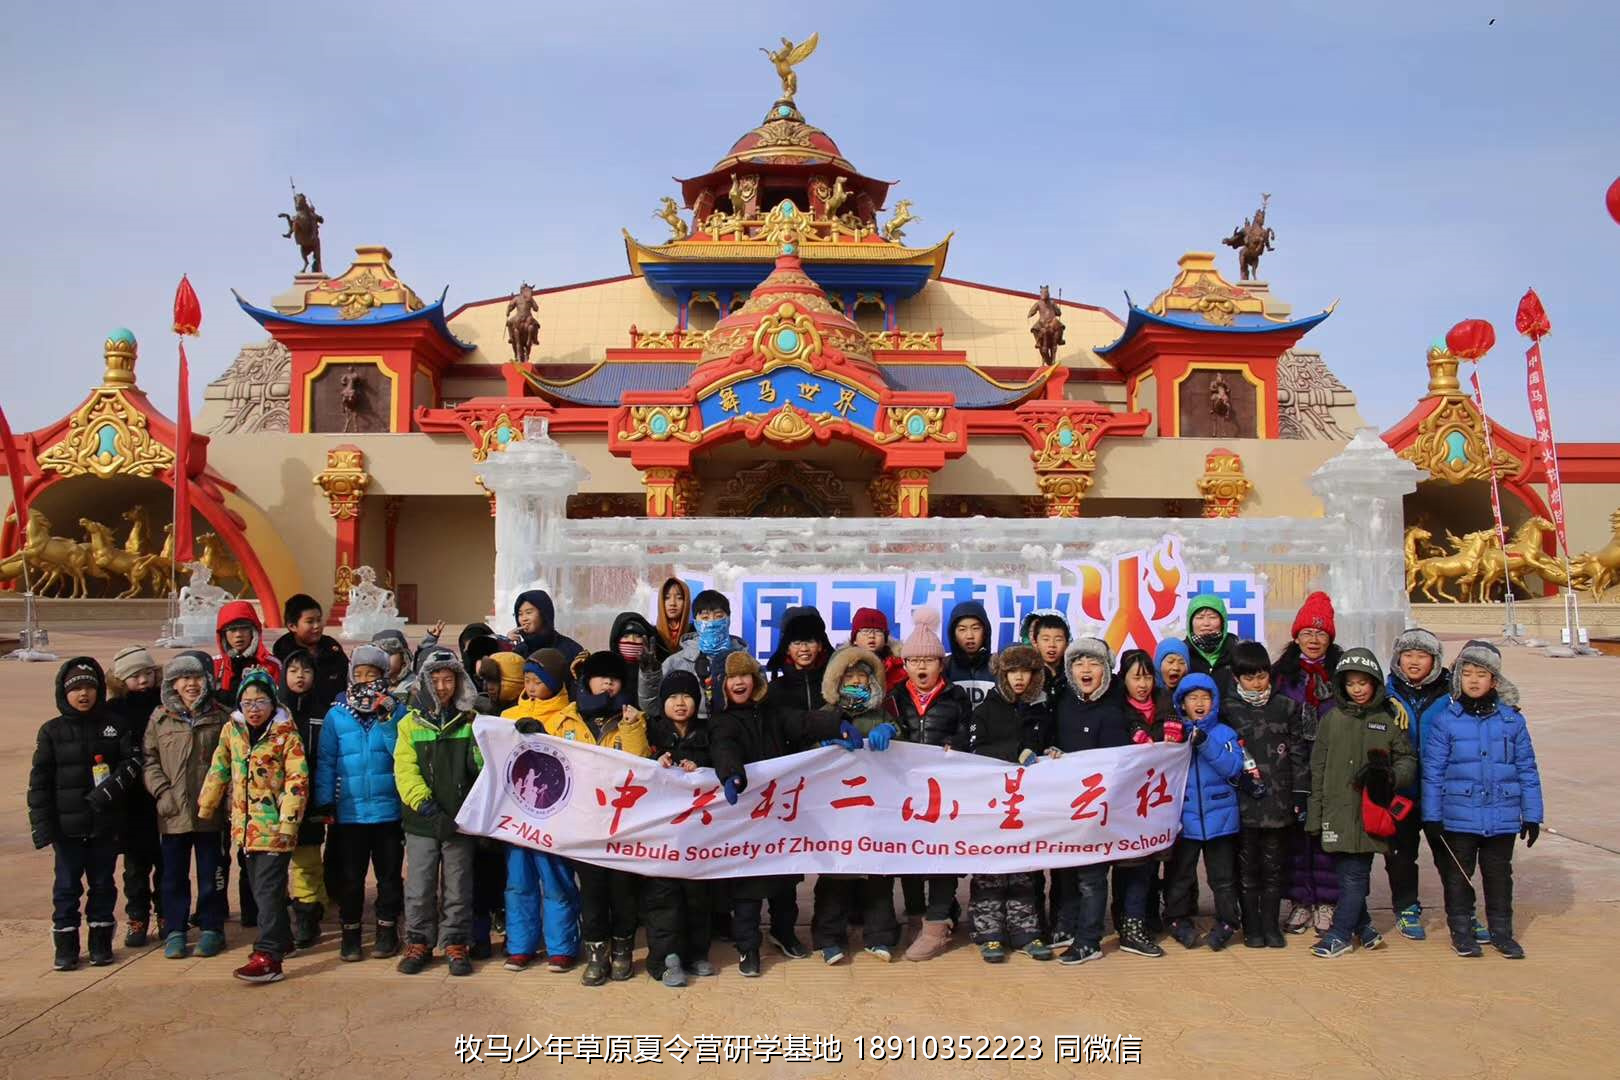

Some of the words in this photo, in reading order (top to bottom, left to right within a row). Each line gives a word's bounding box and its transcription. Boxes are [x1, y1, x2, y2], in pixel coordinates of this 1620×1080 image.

[595, 768, 1174, 838] 中关村二小星云社
[498, 814, 554, 849] Z-NAS
[606, 841, 681, 862] Nabula
[685, 842, 761, 862] Society
[765, 838, 786, 854] of
[789, 837, 853, 857] Zhong
[858, 836, 907, 854] Guan
[911, 839, 950, 856] Cun
[955, 840, 1031, 856] Second
[1035, 840, 1113, 856] Primary
[1119, 828, 1172, 852] School
